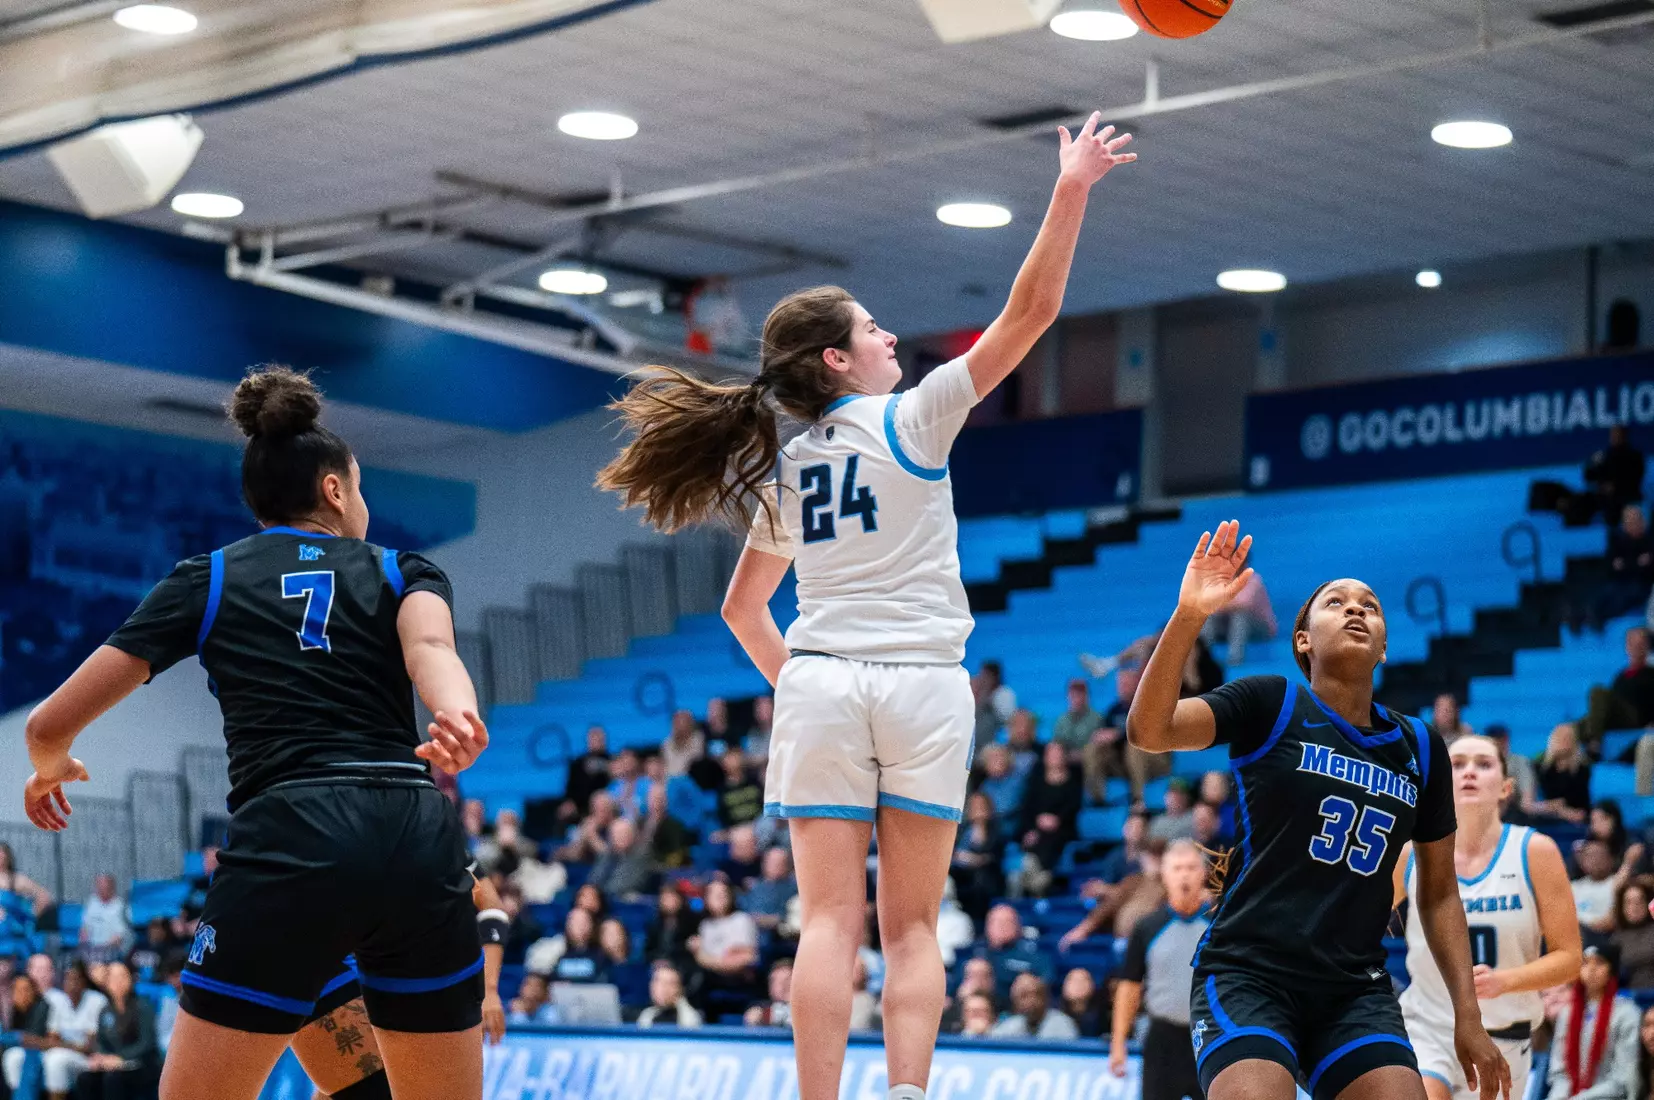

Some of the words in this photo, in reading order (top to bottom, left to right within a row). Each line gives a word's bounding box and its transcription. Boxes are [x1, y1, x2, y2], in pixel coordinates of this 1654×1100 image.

[799, 453, 878, 545] 24
[281, 570, 335, 654] 7
[1296, 741, 1418, 808] Memphis
[1308, 794, 1397, 876] 35
[1462, 893, 1523, 914] MBIA
